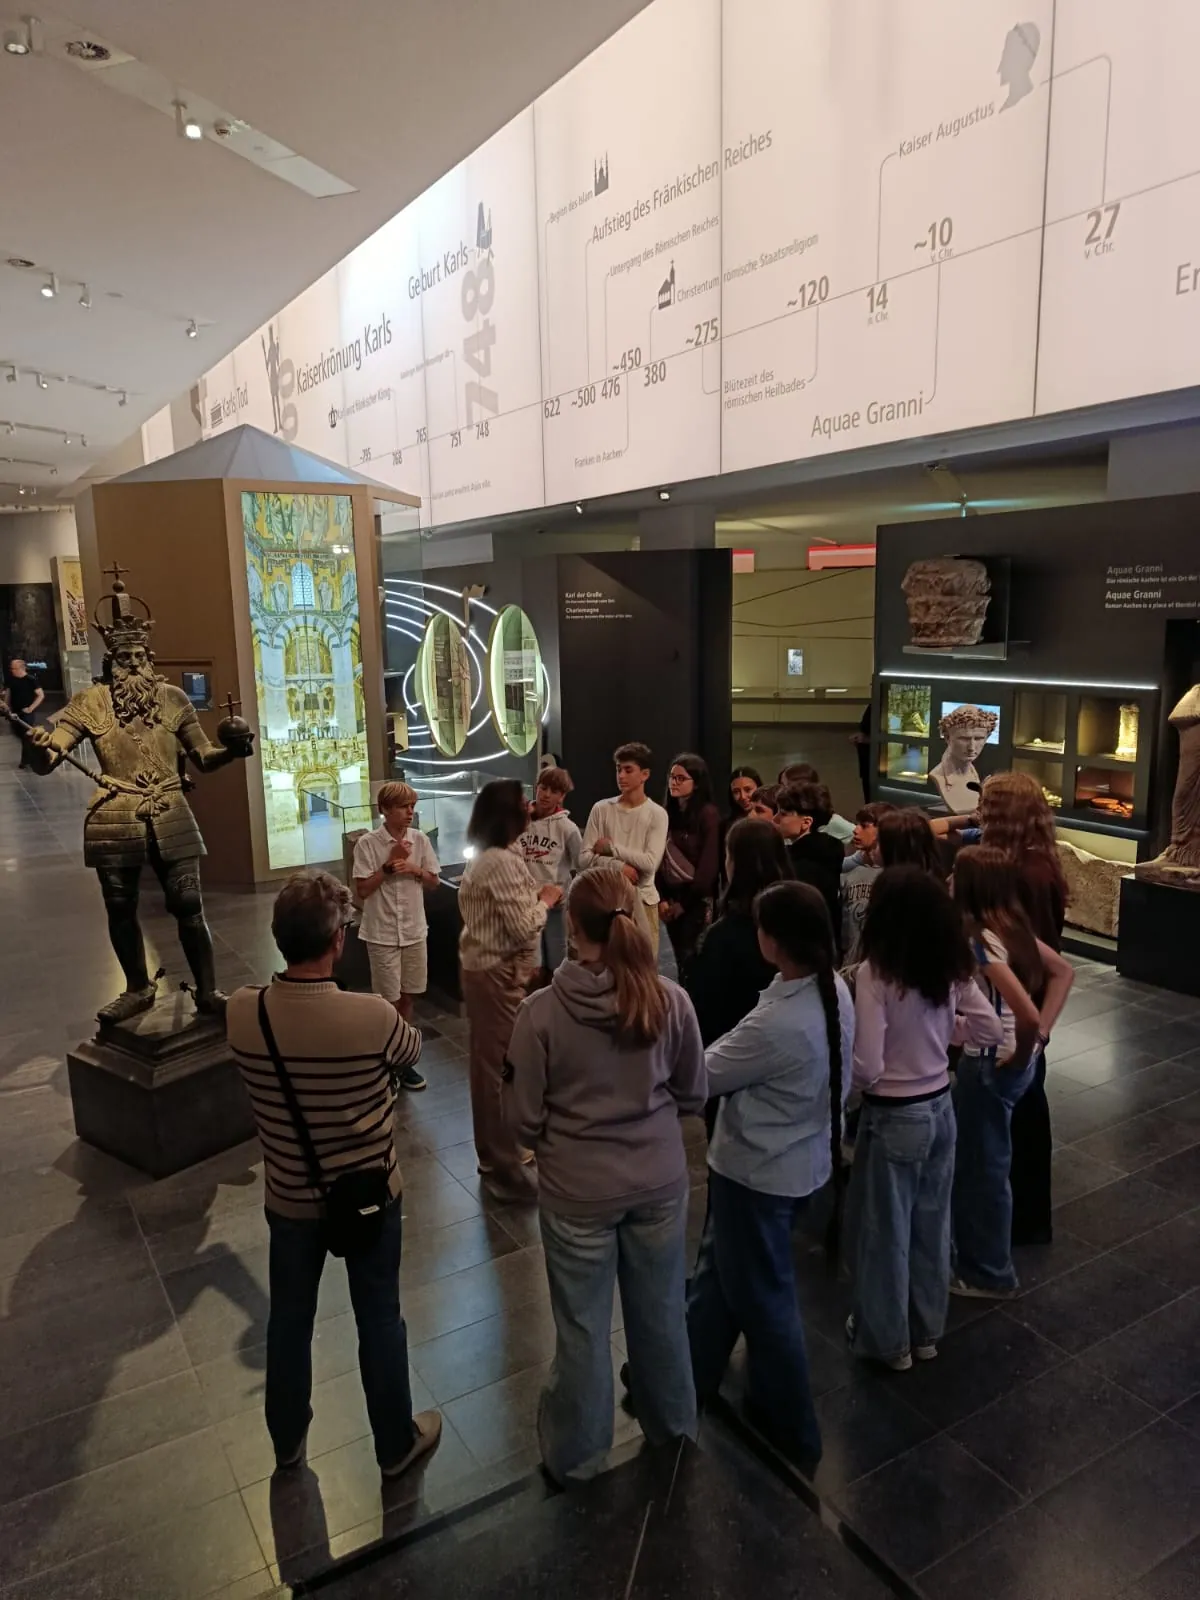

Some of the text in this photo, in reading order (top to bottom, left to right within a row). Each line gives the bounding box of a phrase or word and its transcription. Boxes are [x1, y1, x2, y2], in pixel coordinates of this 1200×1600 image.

[898, 102, 995, 160] Kaiser Augustus
[592, 129, 773, 244] Aufstieg des Fränkischen Reiches
[914, 216, 953, 251] ~10
[1084, 203, 1121, 246] 27
[610, 216, 719, 276] Untergang des Römischen Reiches
[408, 240, 469, 300] Geburt Karls
[677, 276, 719, 303] Christentum
[759, 234, 818, 267] Staatsreligion
[787, 275, 829, 308] ~120
[866, 282, 889, 314] 14
[461, 258, 499, 431] 748
[685, 317, 718, 347] ~275
[296, 338, 362, 397] Kaiserkrönung
[364, 312, 393, 357] Karls
[612, 347, 641, 371] ~450
[601, 376, 620, 400] 476
[644, 361, 666, 387] 380
[724, 369, 774, 394] Blütezeit des
[223, 382, 249, 419] Karls Tod
[544, 397, 561, 419] 622
[571, 385, 596, 408] ~500
[724, 378, 806, 411] römischen Heilbades
[476, 421, 490, 440] 748
[811, 391, 923, 440] Aquae Granni
[416, 427, 427, 445] 765
[450, 431, 461, 448] 751
[1107, 564, 1164, 577] Aquae Granni
[1105, 588, 1162, 602] Aquae Granni
